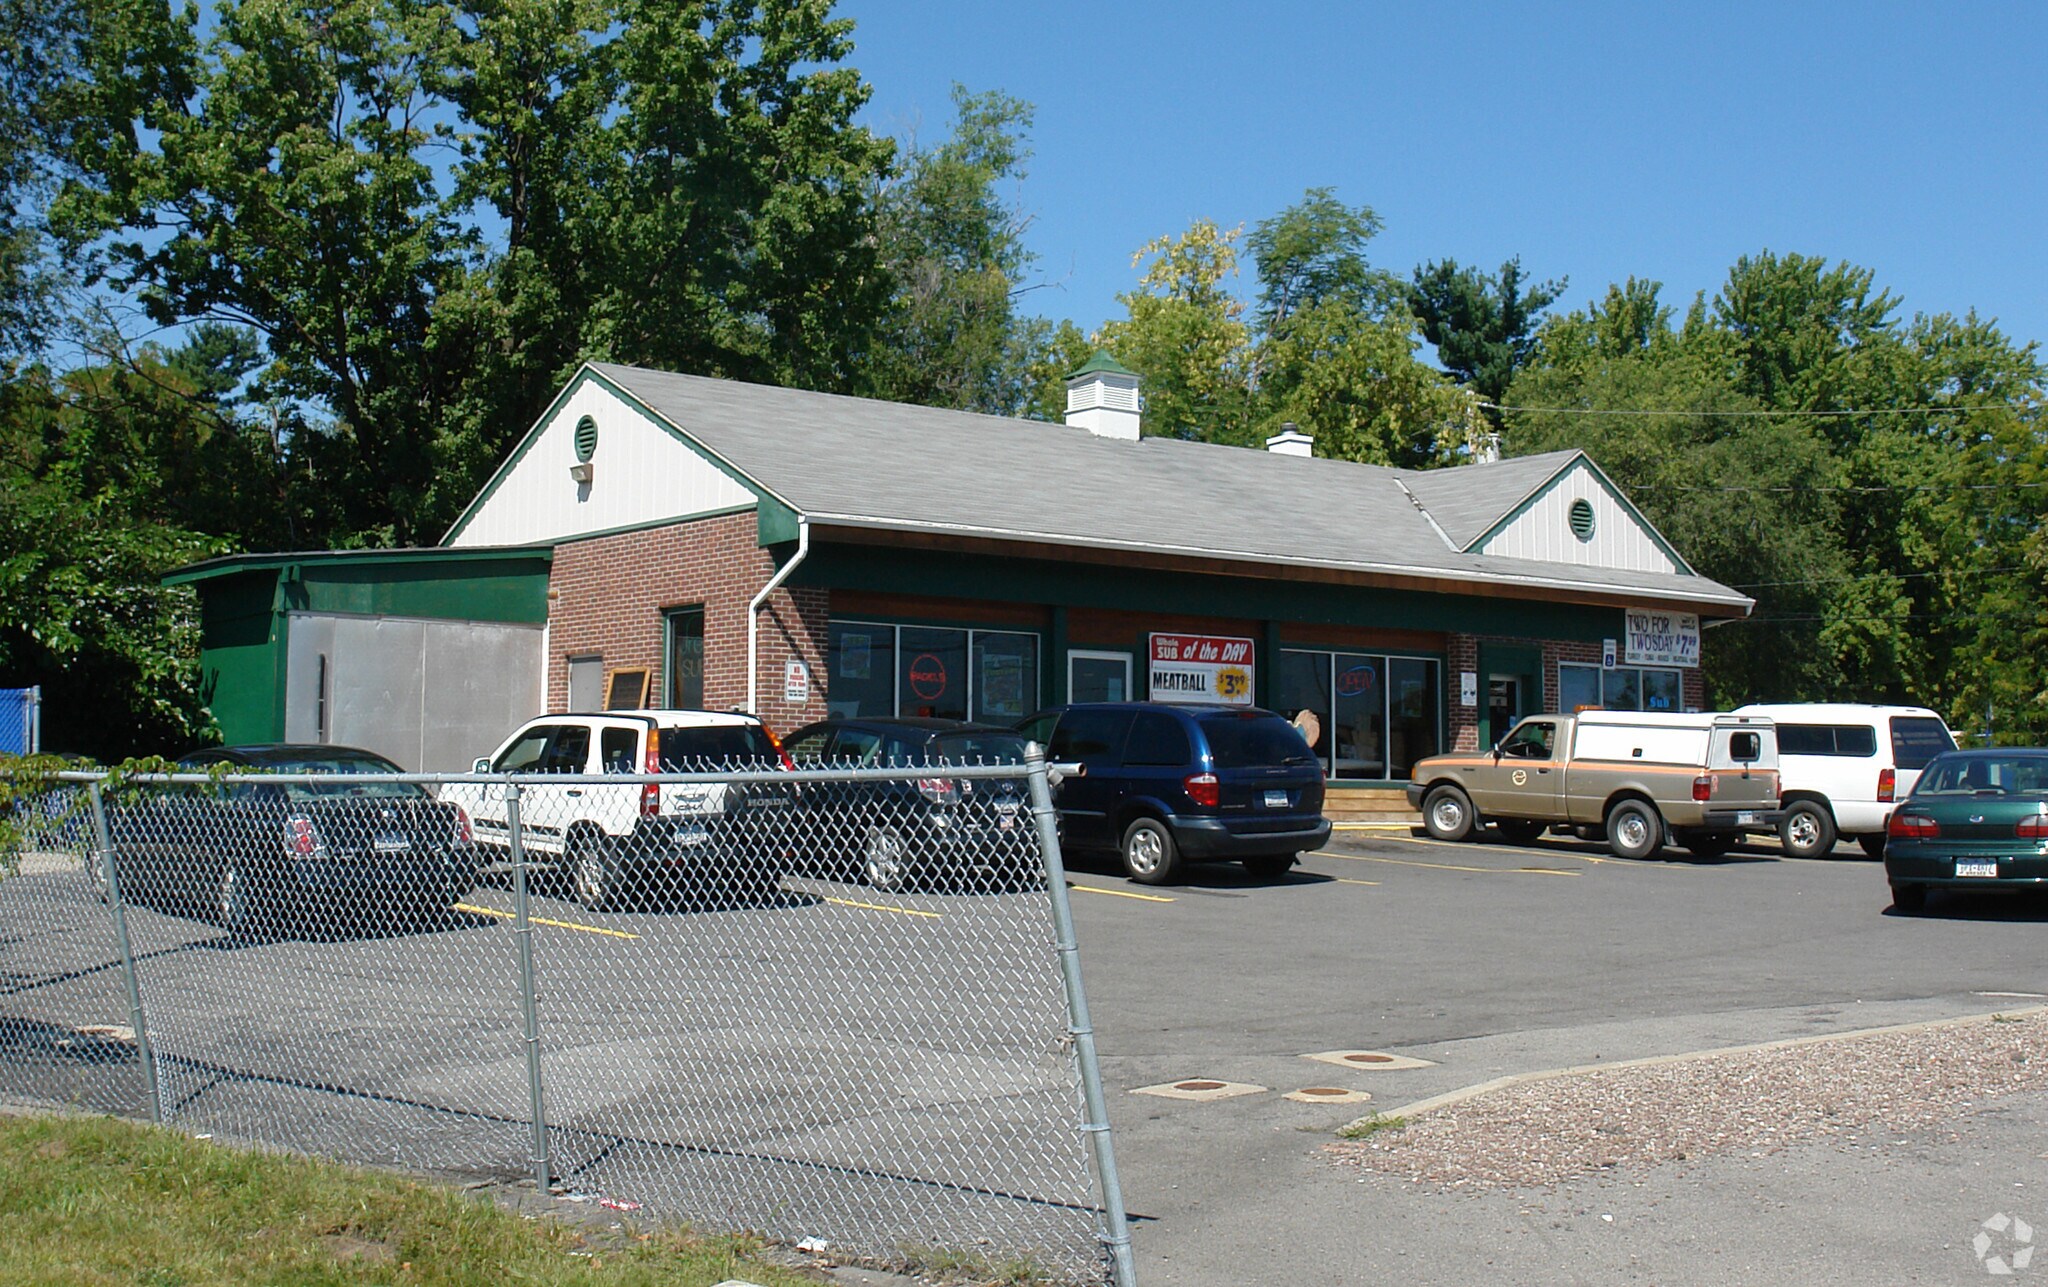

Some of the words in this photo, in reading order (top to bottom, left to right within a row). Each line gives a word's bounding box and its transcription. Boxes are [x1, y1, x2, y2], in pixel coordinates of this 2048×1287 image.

[1627, 615, 1649, 632] TWO
[1652, 616, 1670, 634] FOR
[1157, 648, 1178, 659] SUB
[1183, 641, 1198, 659] of
[1199, 642, 1219, 660] the
[1221, 643, 1248, 662] DAY
[1630, 633, 1674, 651] TWOSDAY
[1153, 672, 1206, 691] MEATBALL
[1338, 671, 1372, 691] OPEN
[1649, 696, 1670, 708] Sub
[747, 797, 789, 806] HONDA
